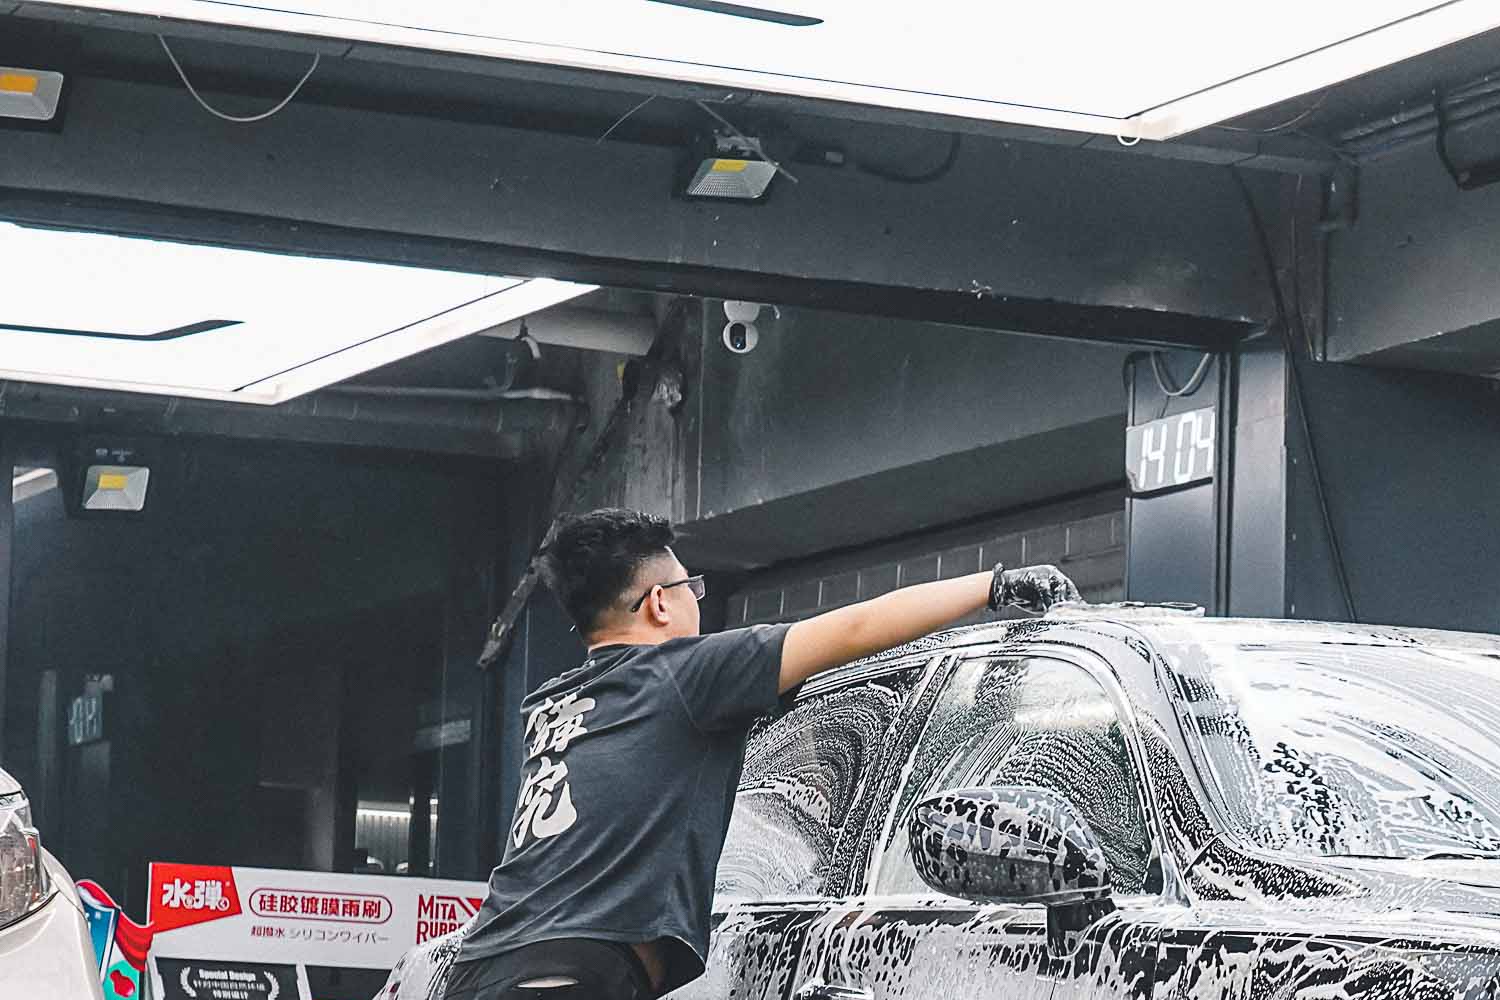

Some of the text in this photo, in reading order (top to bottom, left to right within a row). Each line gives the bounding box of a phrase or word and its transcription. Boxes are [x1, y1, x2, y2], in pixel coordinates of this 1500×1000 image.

[258, 893, 382, 919] 硅胶镀膜雨刷
[417, 894, 457, 920] MITA
[289, 928, 390, 944] シリコンワイパー
[416, 920, 465, 945] RUBB
